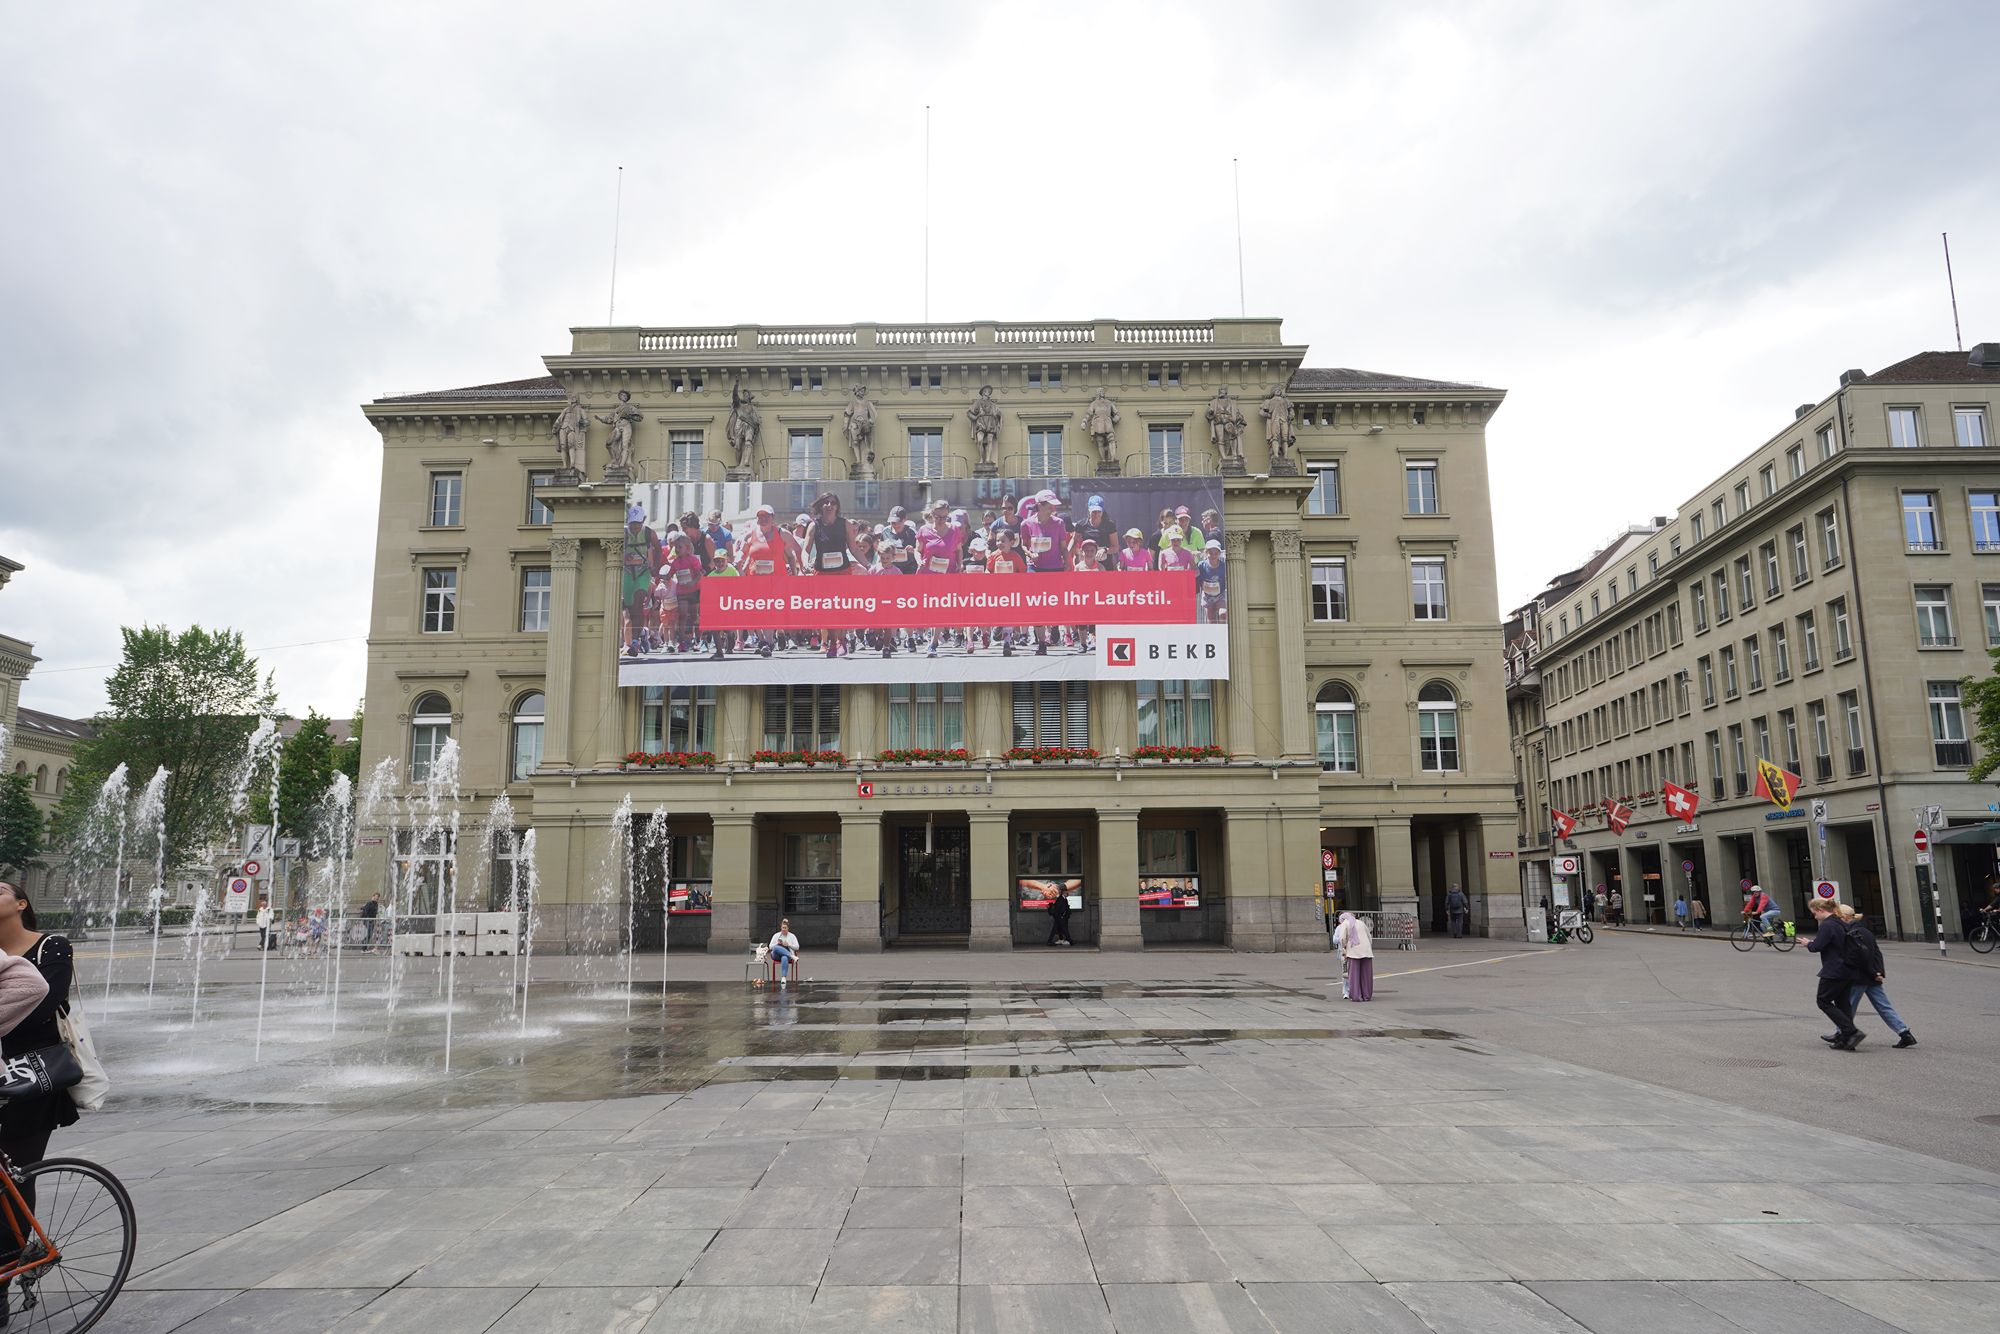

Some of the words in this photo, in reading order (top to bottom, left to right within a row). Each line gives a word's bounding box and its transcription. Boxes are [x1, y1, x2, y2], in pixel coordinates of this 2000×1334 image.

[719, 595, 785, 611] Unsere
[790, 595, 876, 613] Beratung
[896, 597, 918, 609] so
[923, 593, 1021, 609] individuell
[1025, 592, 1059, 607] wie
[1064, 591, 1090, 606] Ihr
[1094, 590, 1172, 606] Laufstil.
[37, 1071, 51, 1091] GUESS
